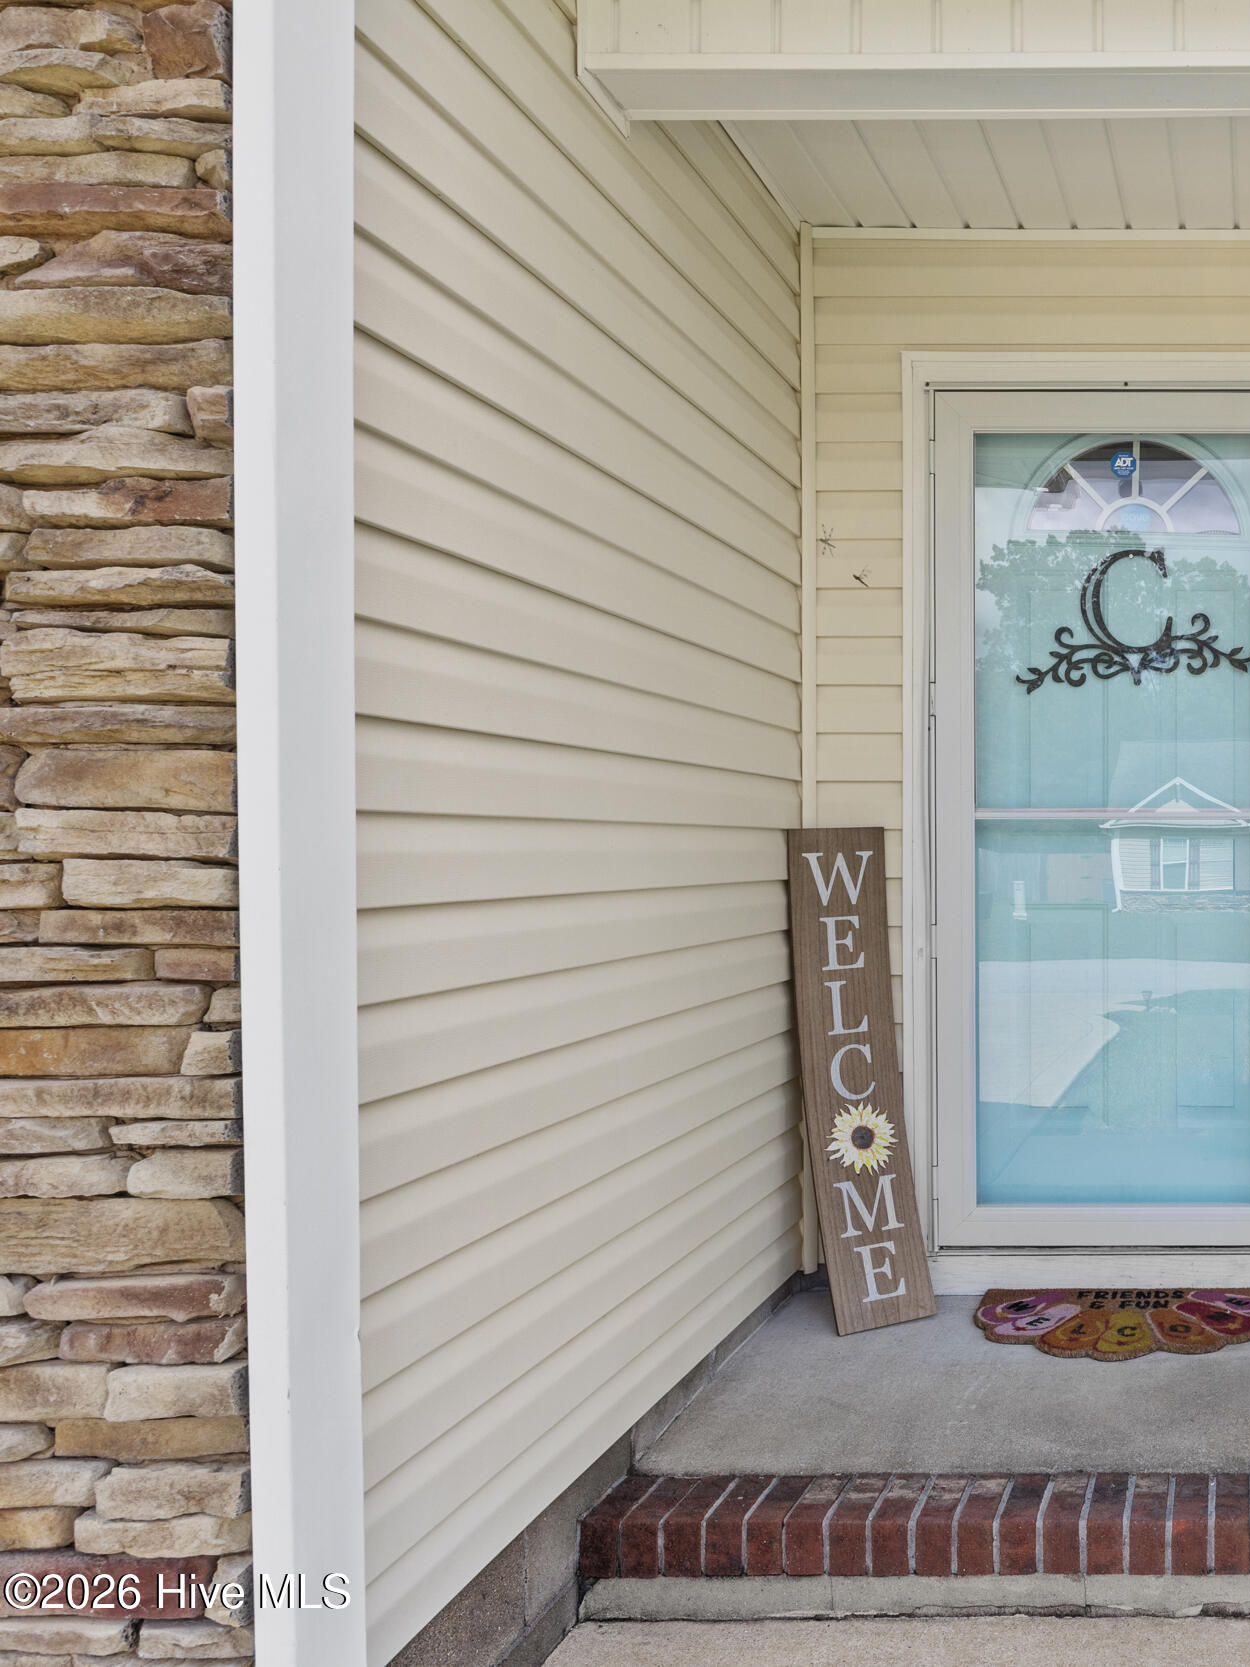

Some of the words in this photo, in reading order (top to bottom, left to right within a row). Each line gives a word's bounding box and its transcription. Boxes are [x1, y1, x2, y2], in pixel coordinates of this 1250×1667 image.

[1114, 457, 1134, 467] ADT
[1080, 549, 1173, 653] C
[801, 850, 907, 1303] WELCME
[1076, 1290, 1185, 1300] FRIENDS
[1118, 1300, 1170, 1309] FUN
